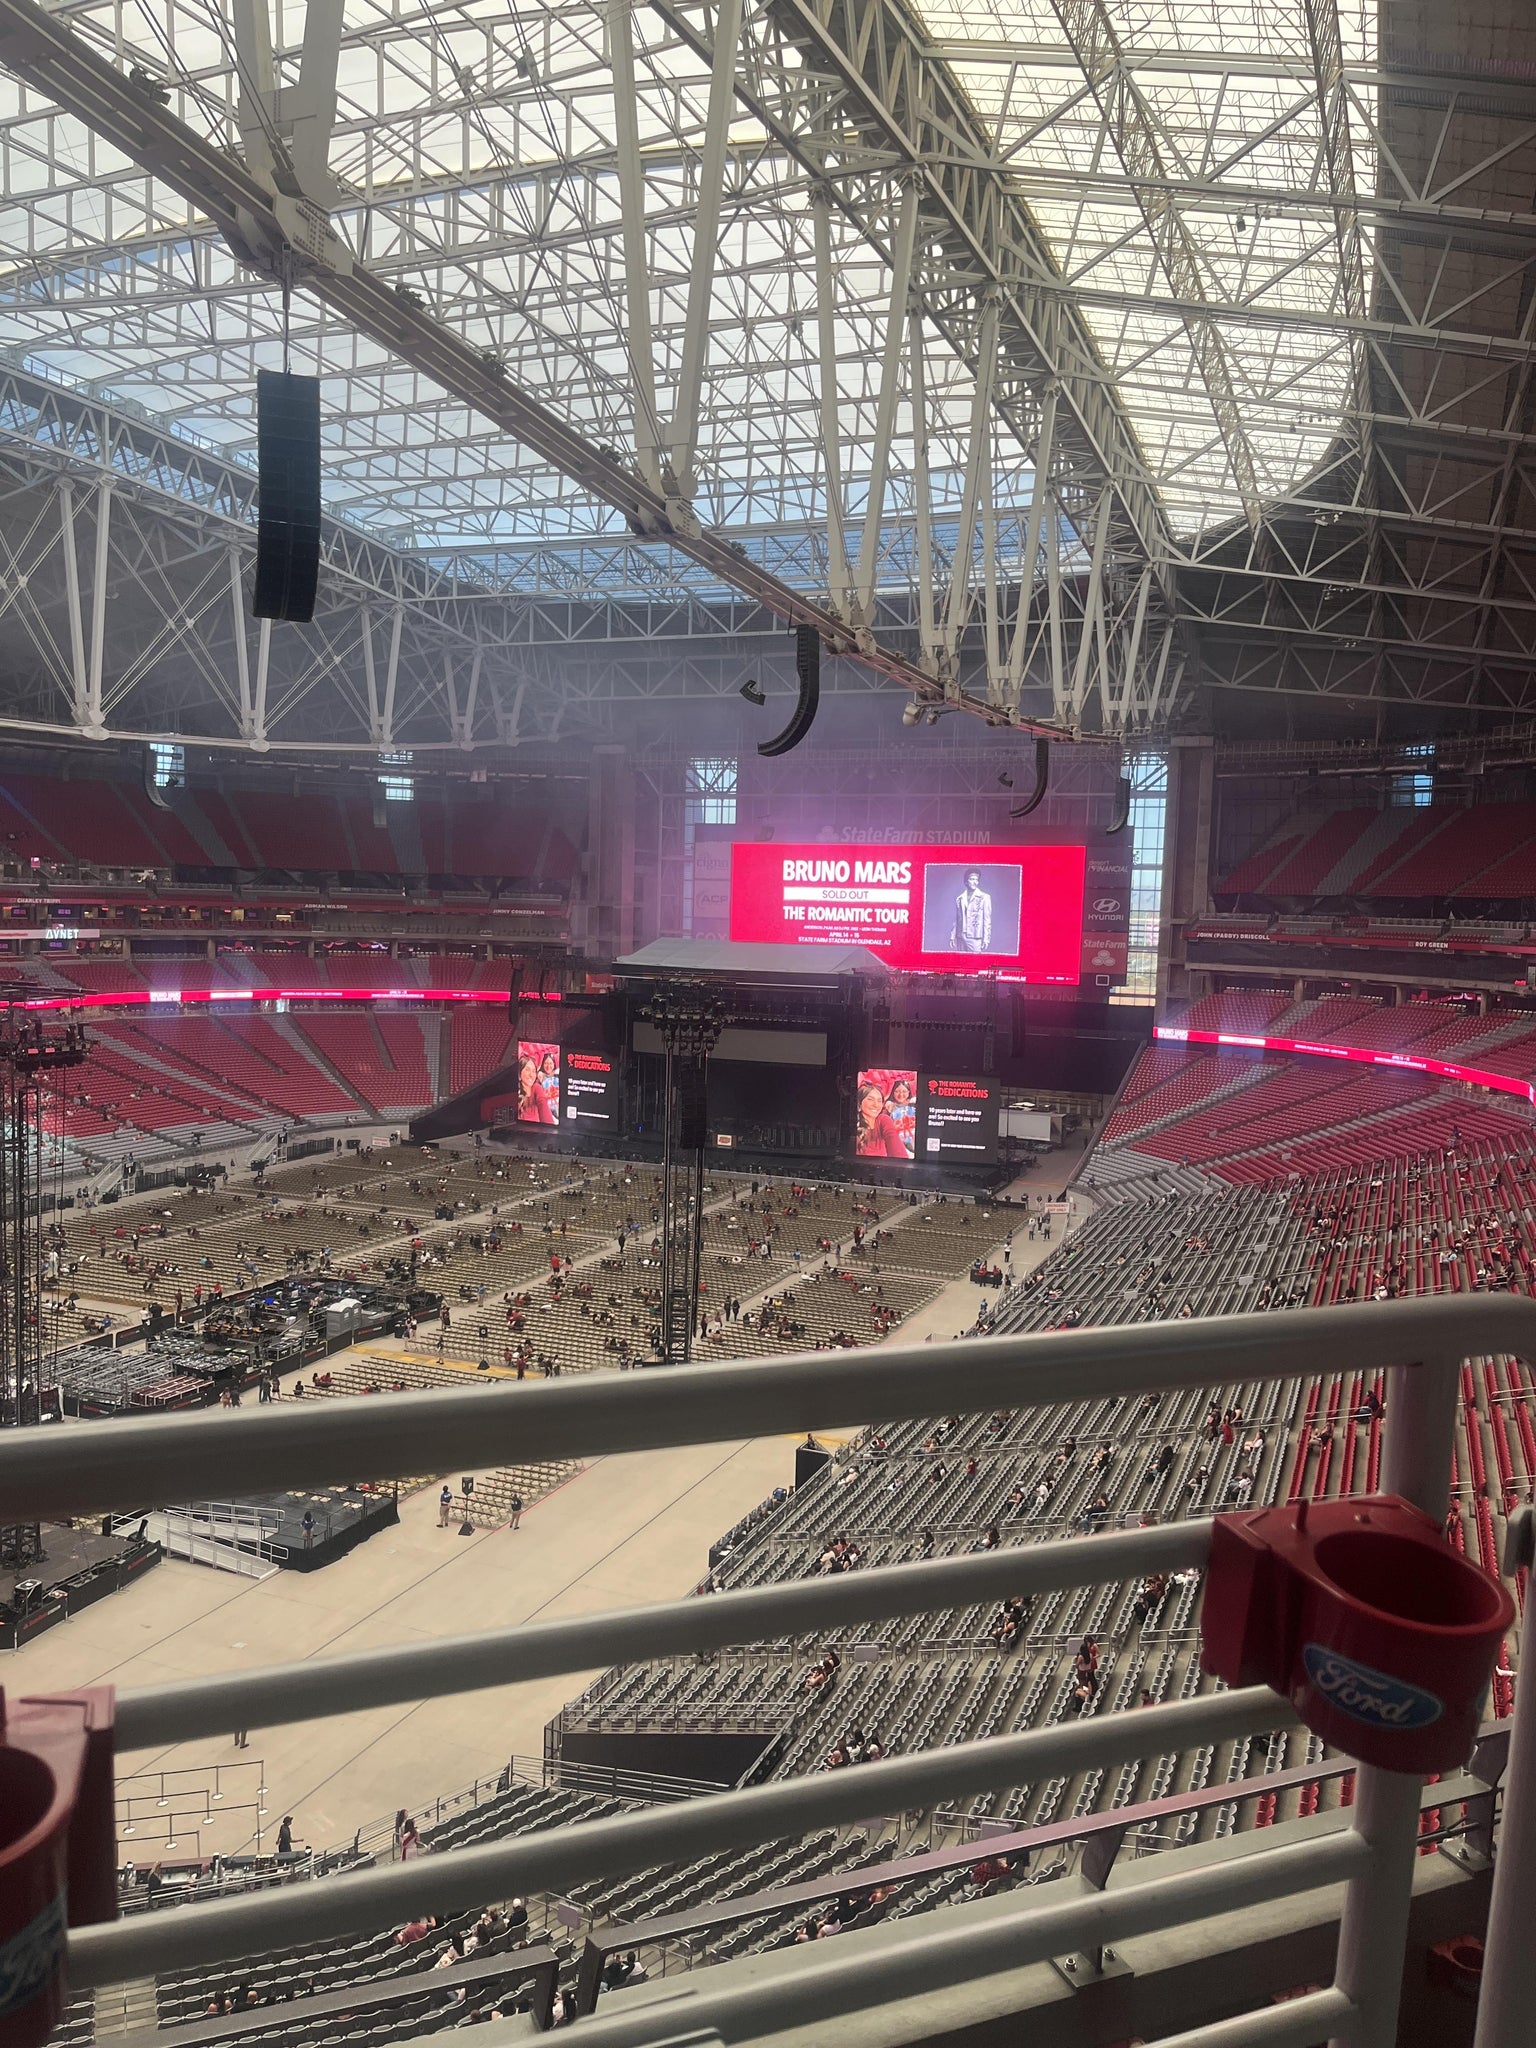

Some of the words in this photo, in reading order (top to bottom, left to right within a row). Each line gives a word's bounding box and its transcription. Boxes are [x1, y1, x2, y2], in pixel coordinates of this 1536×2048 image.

[926, 831, 990, 844] STADIUM
[783, 860, 850, 882] BRUNO
[855, 861, 911, 884] MARS
[822, 890, 846, 899] SOLD
[849, 891, 869, 899] OUT
[783, 906, 805, 920] THE
[808, 907, 873, 923] ROMANTIC
[875, 908, 909, 924] TOUR
[46, 929, 79, 939] AVNET
[574, 1061, 610, 1071] DEDICATIONS
[938, 1087, 989, 1099] DEDICATIONS
[1317, 1660, 1416, 1723] Ford
